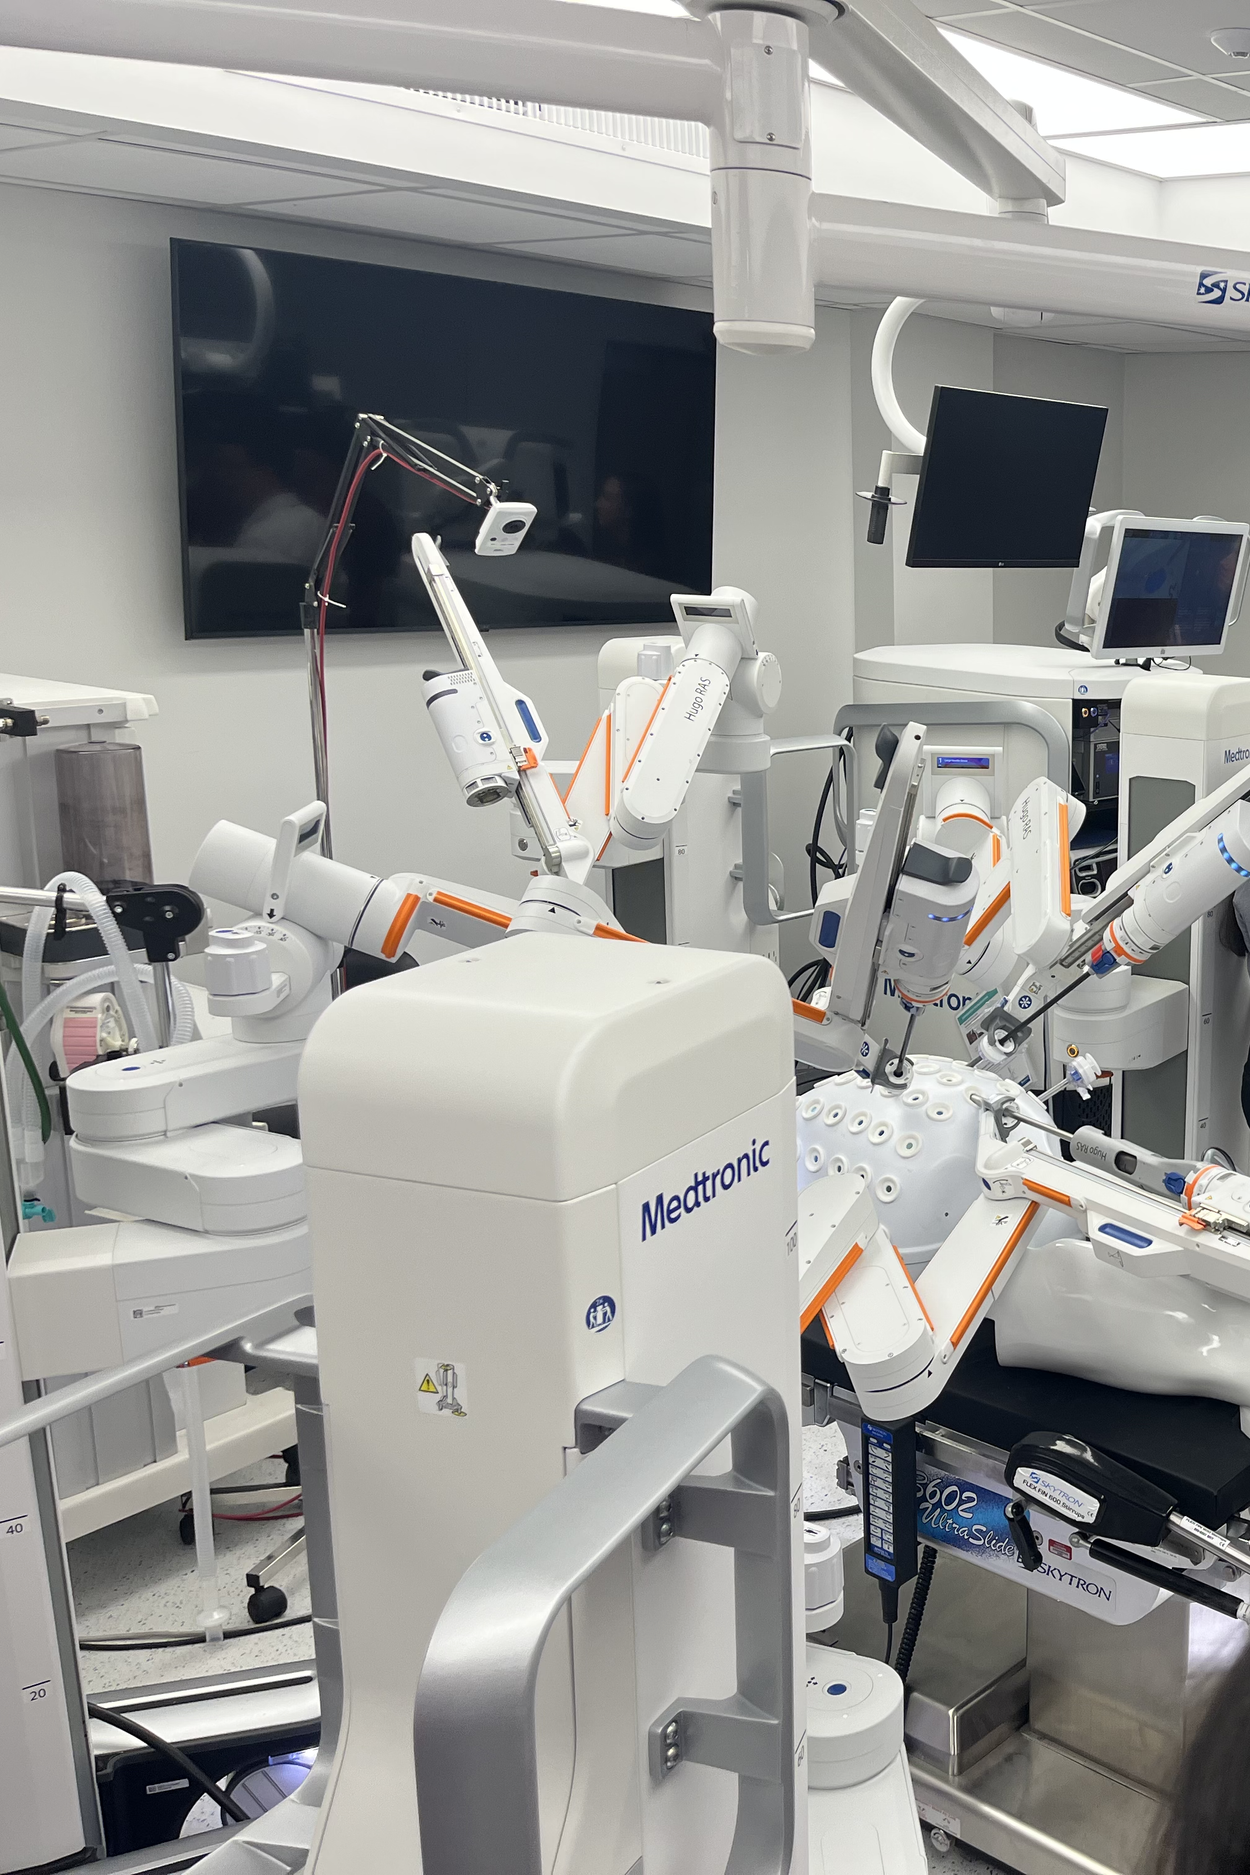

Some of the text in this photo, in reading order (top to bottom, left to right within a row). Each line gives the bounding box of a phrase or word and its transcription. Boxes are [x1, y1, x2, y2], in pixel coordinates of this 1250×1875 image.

[684, 676, 711, 722] Hugo RAS
[641, 1138, 771, 1243] Medtronic
[786, 1231, 798, 1257] 100
[1022, 1479, 1038, 1492] FLEX
[1037, 1487, 1048, 1498] FIN
[1048, 1493, 1062, 1505] 600
[1039, 1480, 1084, 1508] SKYTRON
[6, 1523, 23, 1535] 40
[1037, 1562, 1112, 1602] SKYTRON
[29, 1688, 47, 1702] 20
